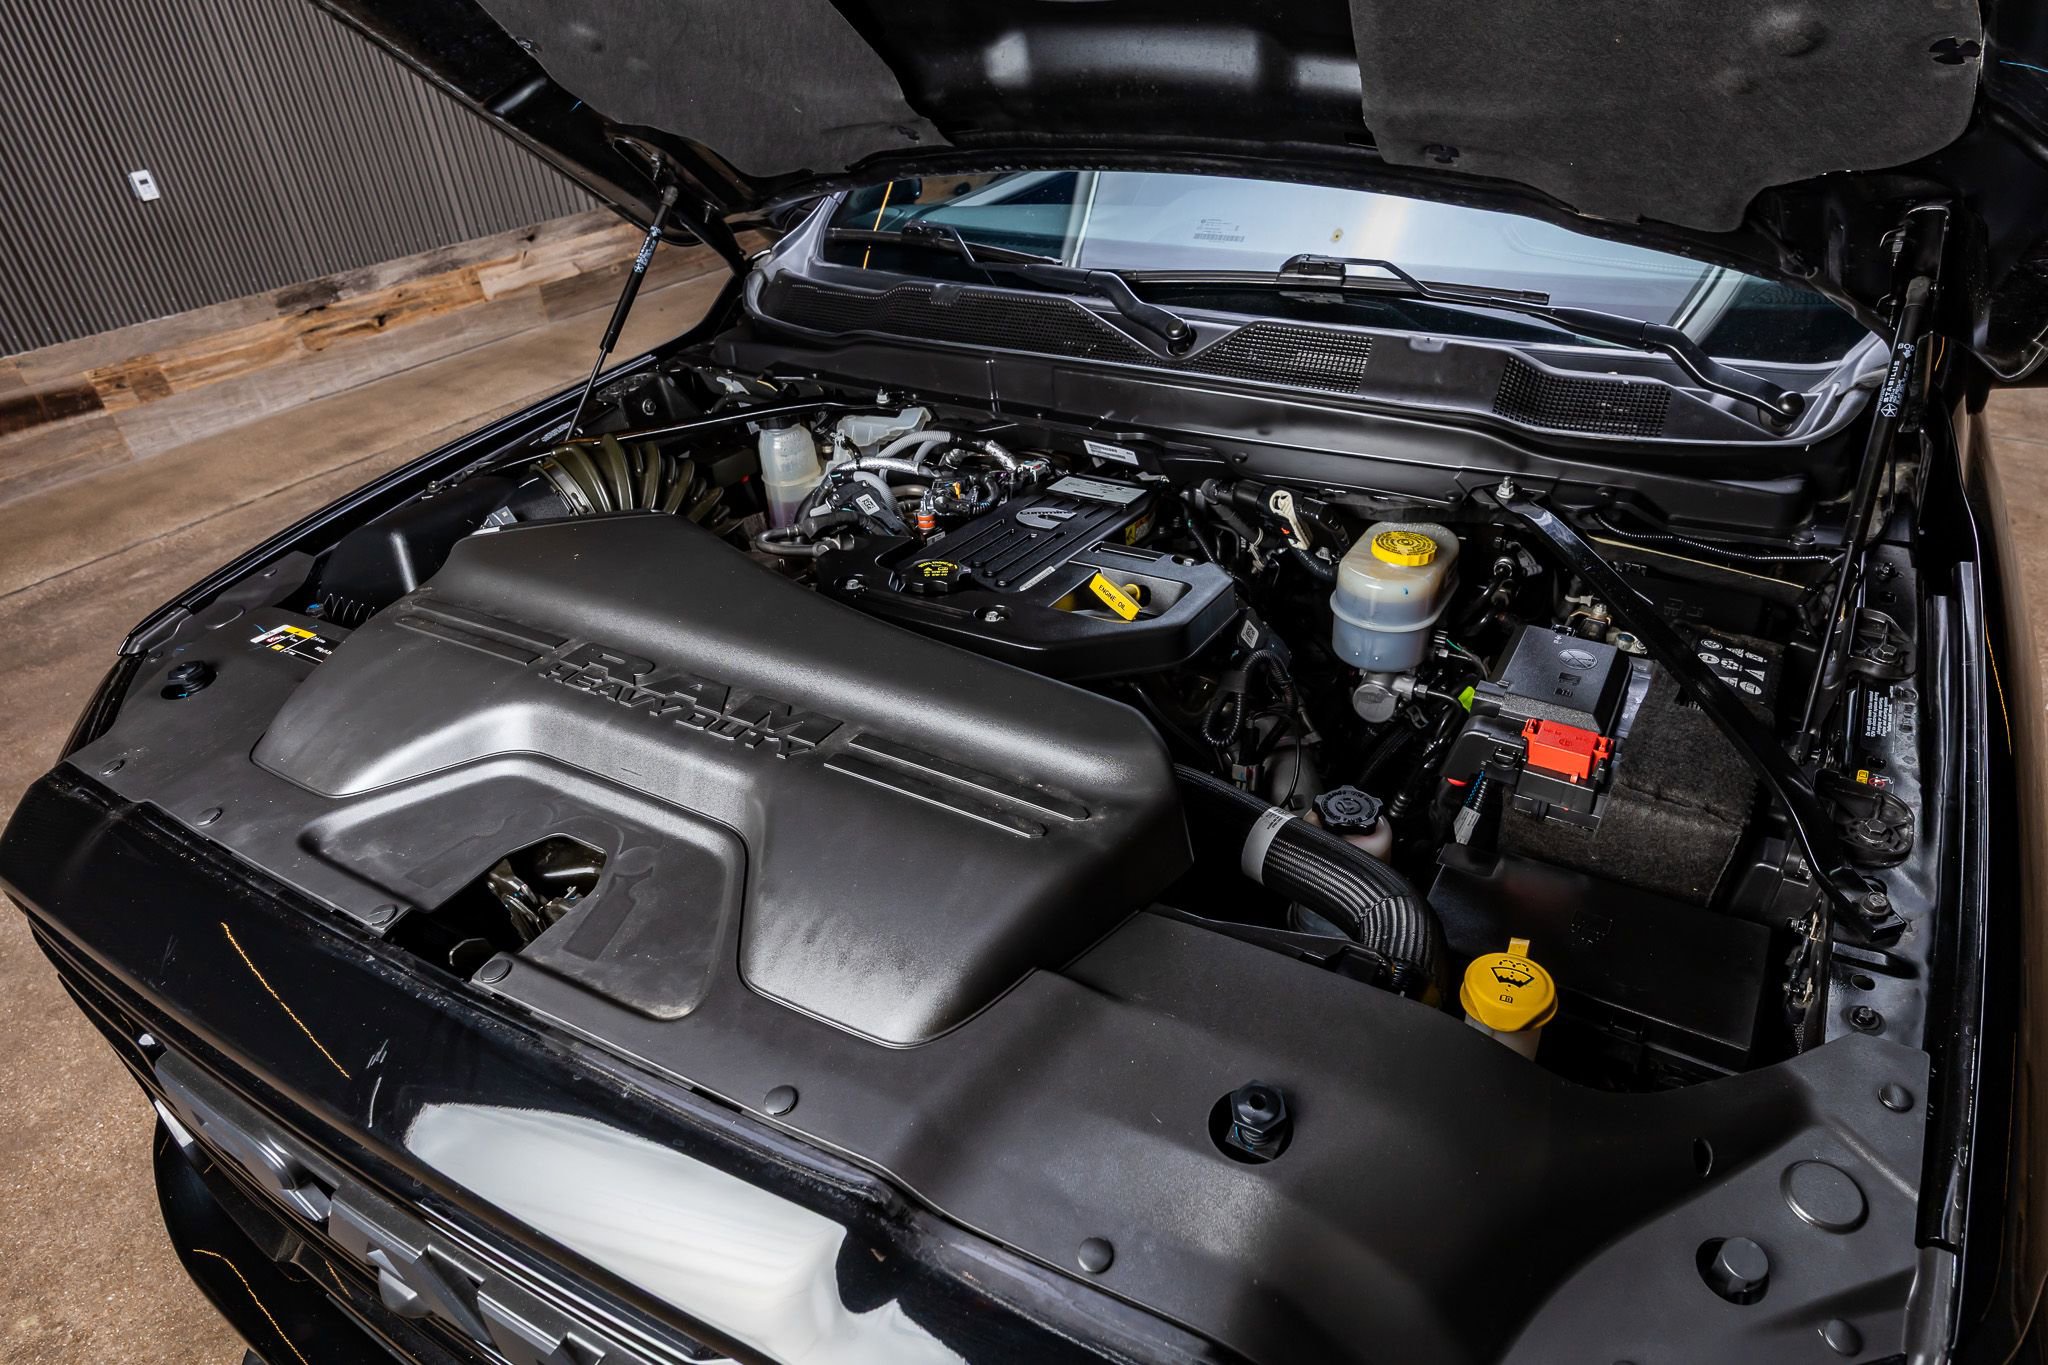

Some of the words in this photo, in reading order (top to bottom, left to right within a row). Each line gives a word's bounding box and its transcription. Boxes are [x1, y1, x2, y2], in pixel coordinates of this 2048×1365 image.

[1883, 360, 1900, 403] STABILUS
[1098, 584, 1117, 603] ENGINE
[1117, 601, 1126, 611] OIL
[537, 663, 684, 717] HEAVY
[674, 710, 817, 760] DUTY
[558, 641, 846, 748] RAM
